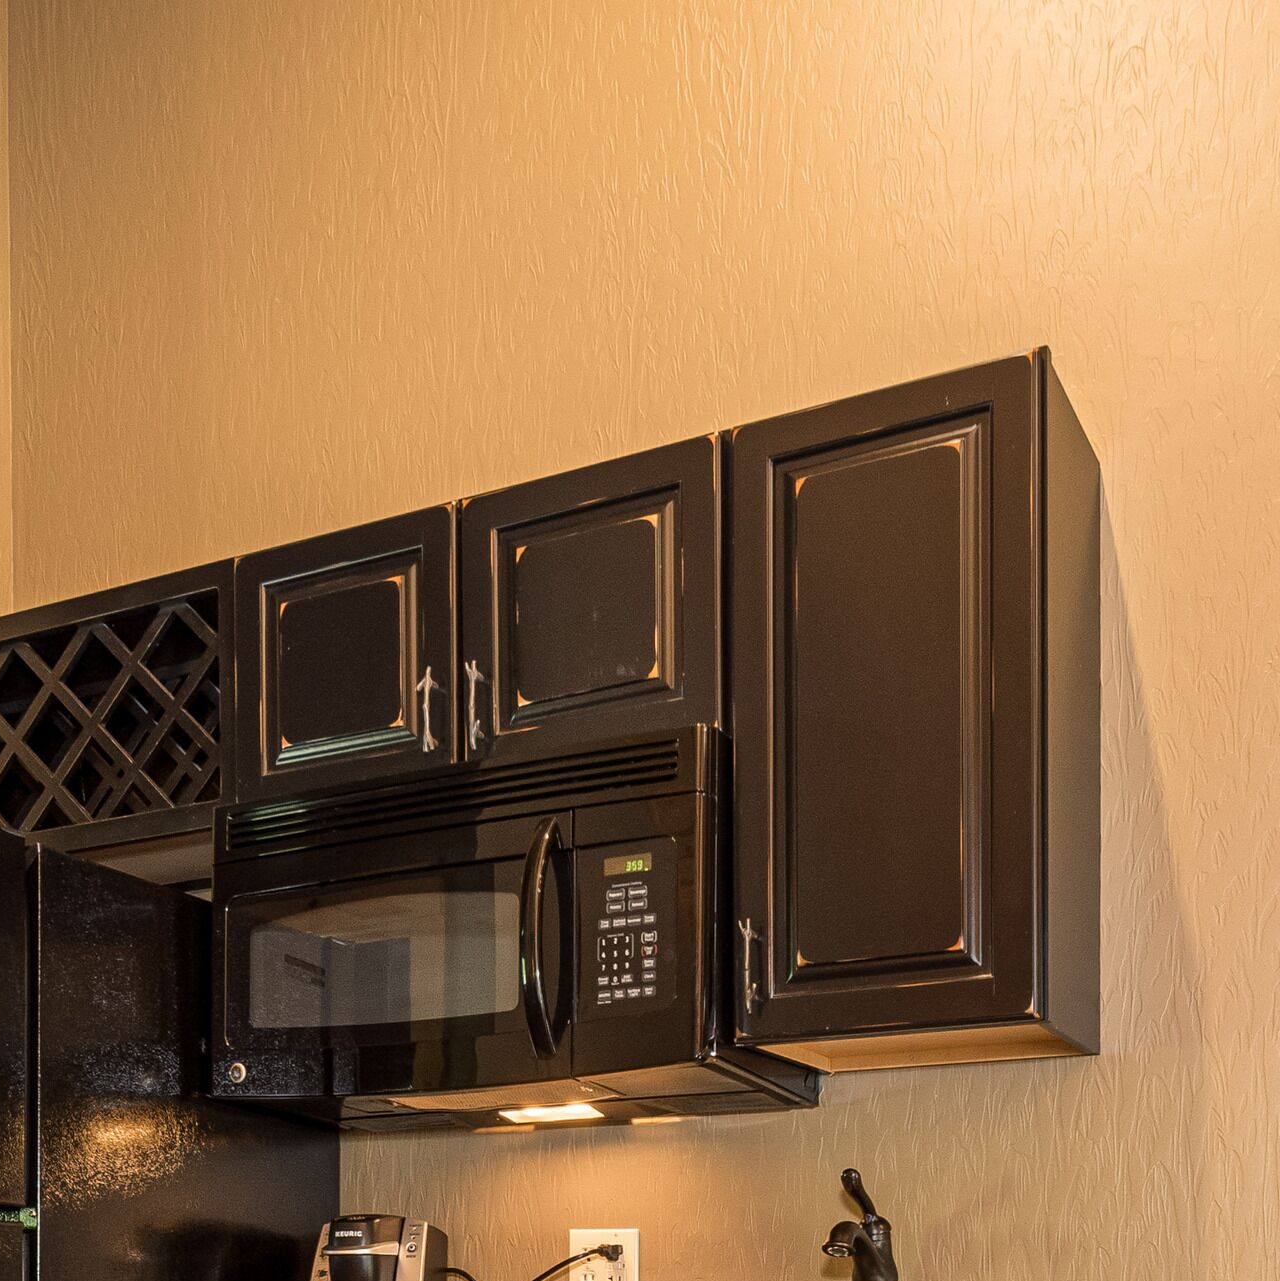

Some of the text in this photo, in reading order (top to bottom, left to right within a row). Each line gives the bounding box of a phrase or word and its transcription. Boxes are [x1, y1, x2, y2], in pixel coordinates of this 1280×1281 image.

[613, 937, 618, 945] 2
[624, 948, 630, 956] 6
[335, 1230, 363, 1238] KEURIG
